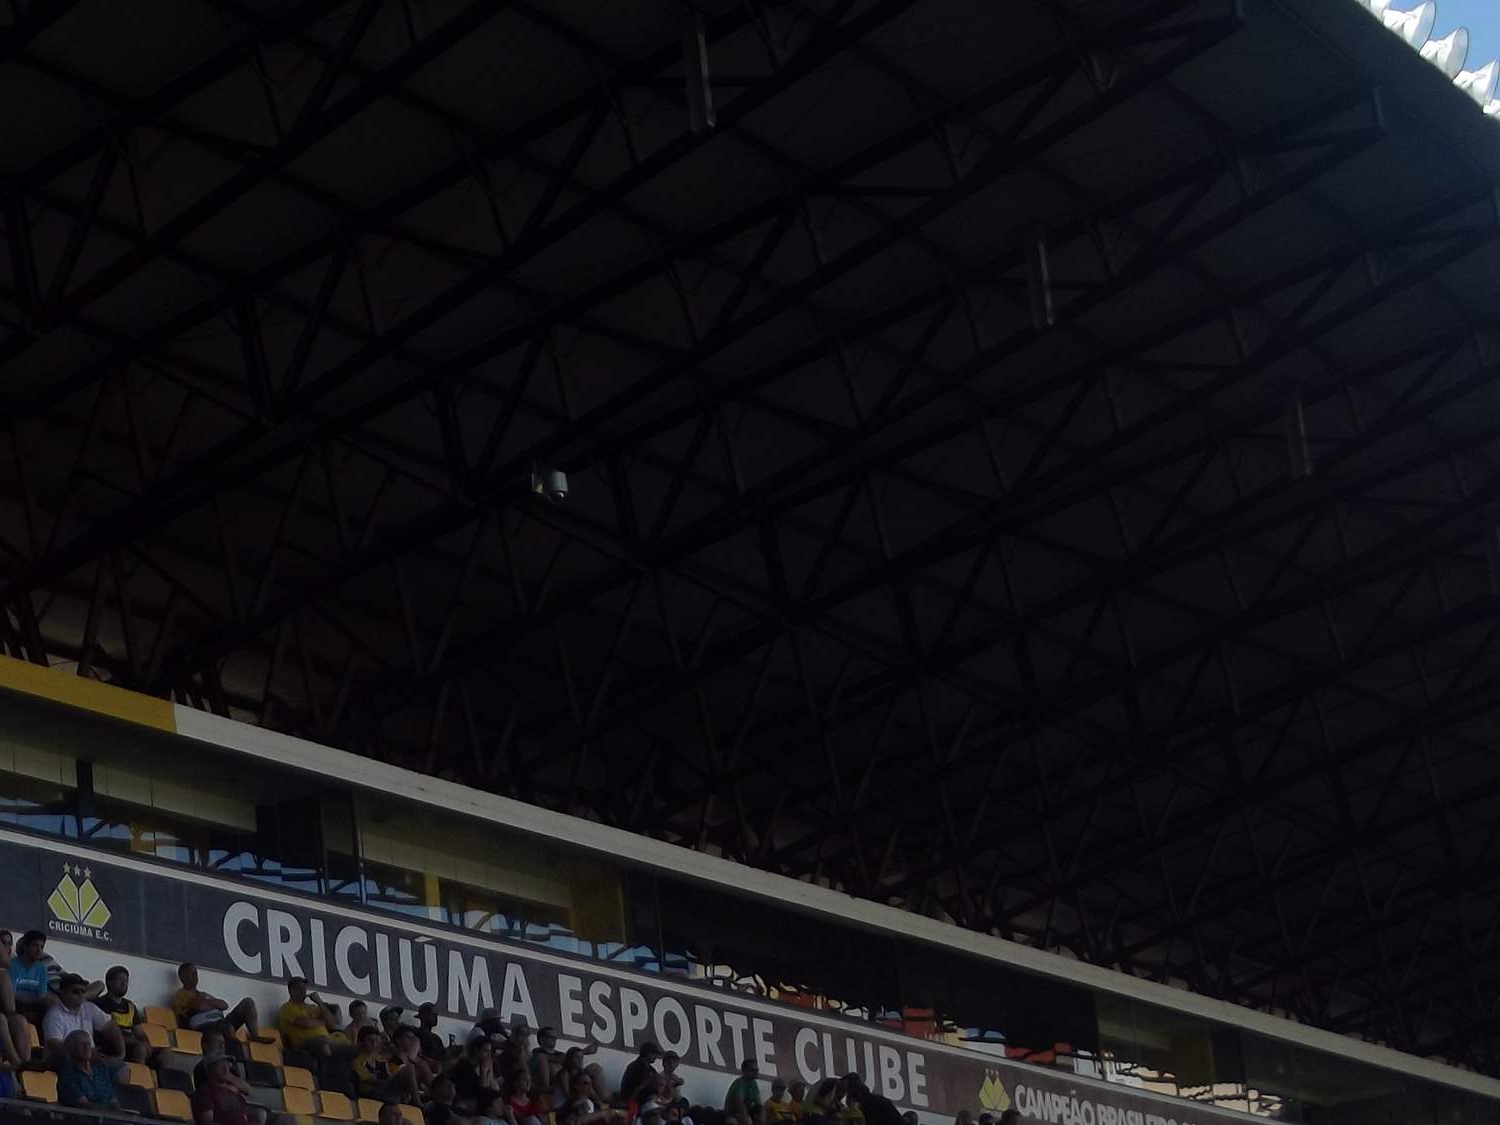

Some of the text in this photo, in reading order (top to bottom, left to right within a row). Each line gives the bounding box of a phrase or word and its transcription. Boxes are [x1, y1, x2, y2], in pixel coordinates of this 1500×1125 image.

[223, 901, 931, 1109] CRICIÚMA ESPORTE CLUBE
